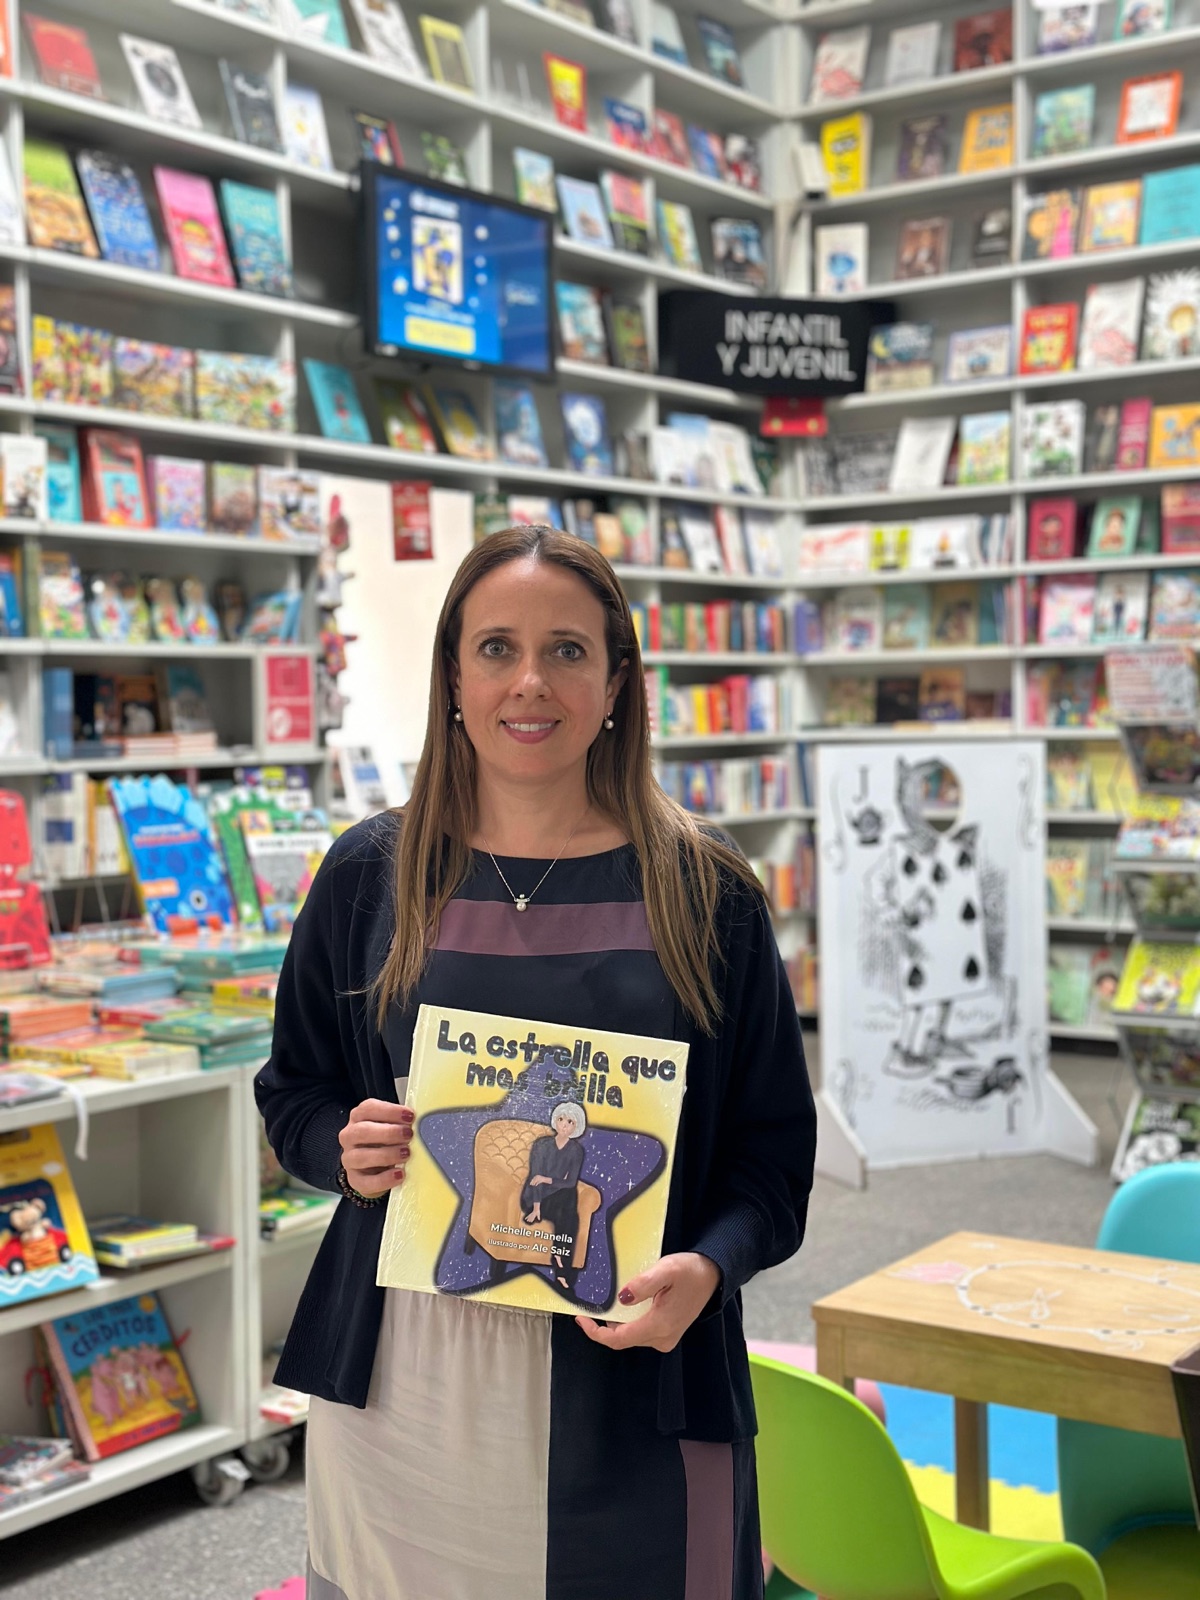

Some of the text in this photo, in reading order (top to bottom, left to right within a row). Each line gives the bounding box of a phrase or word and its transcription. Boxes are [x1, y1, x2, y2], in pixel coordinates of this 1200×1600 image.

[725, 310, 849, 348] INFANTIL
[716, 342, 857, 381] Y JUVENIL
[437, 1020, 676, 1084] La estrella que
[544, 1071, 623, 1108] brilla
[490, 1223, 573, 1244] Michelle Planella
[531, 1243, 548, 1253] Ale
[550, 1246, 571, 1257] Saiz
